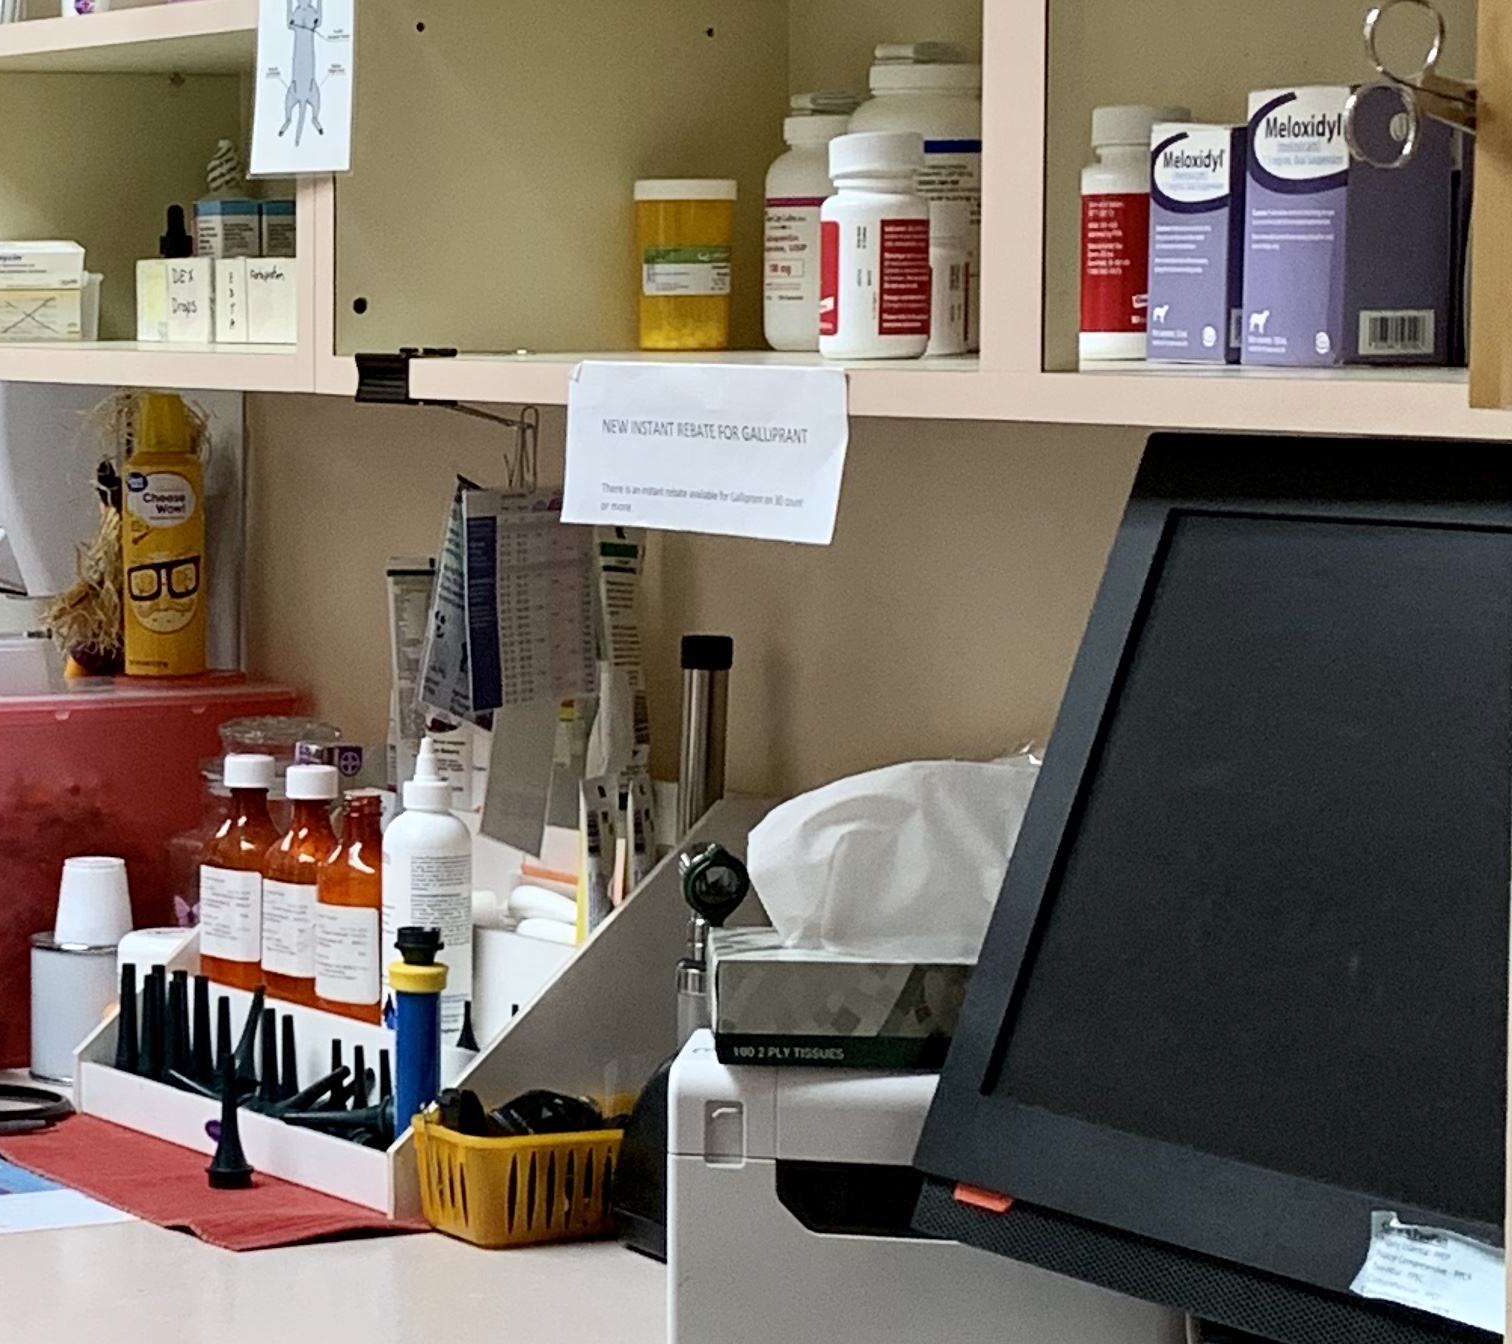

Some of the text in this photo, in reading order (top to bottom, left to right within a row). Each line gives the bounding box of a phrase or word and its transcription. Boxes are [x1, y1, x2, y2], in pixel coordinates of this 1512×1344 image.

[1265, 112, 1343, 143] Meloxidyl
[1163, 148, 1225, 172] Meloxidyl
[602, 419, 808, 444] NEW INSTANT REBATE FOR GALLIPRANT
[602, 483, 623, 494] There
[143, 492, 186, 503] Cheese
[156, 504, 186, 514] Wow!
[758, 1047, 765, 1057] 2
[768, 1047, 791, 1058] PLY
[793, 1047, 845, 1060] TISSUES
